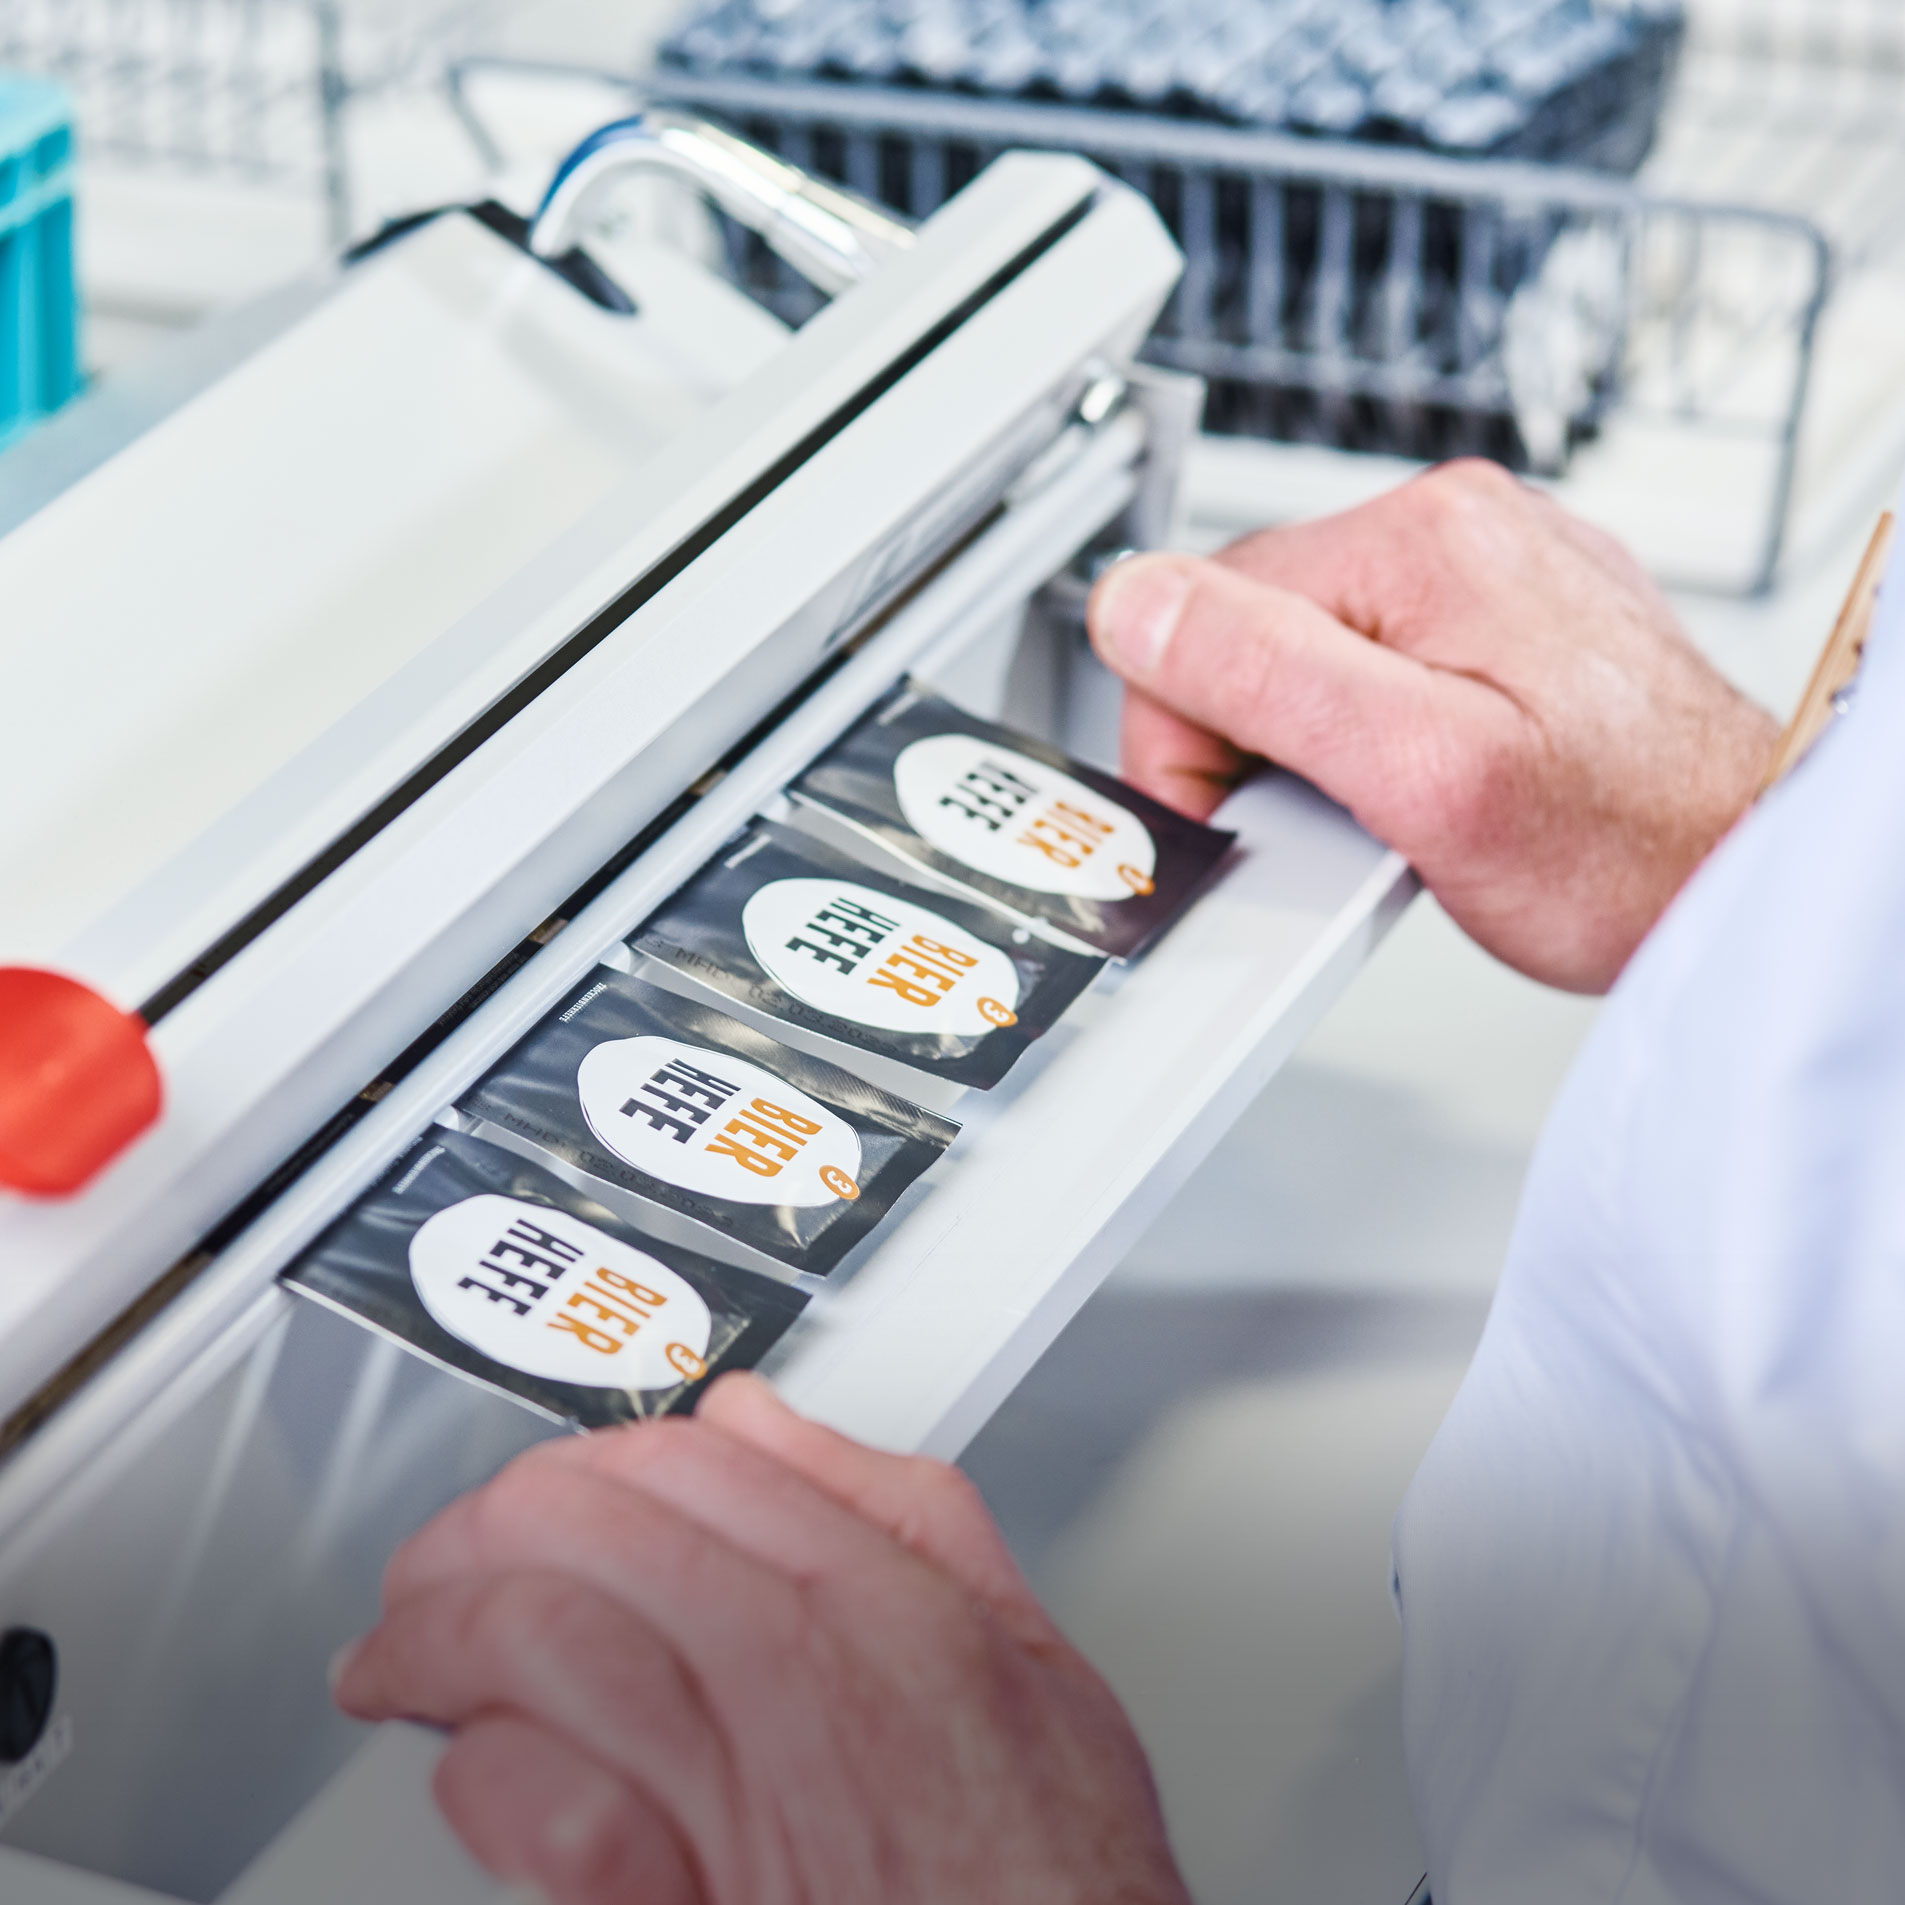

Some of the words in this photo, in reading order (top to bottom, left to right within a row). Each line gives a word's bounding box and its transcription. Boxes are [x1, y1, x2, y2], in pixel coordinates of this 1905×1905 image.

[785, 896, 901, 976] HEFE
[866, 934, 979, 1008] BIER
[618, 1058, 742, 1145] HEFE
[705, 1097, 823, 1178] BIER
[457, 1218, 586, 1317] HEFE
[547, 1267, 668, 1355] BIER
